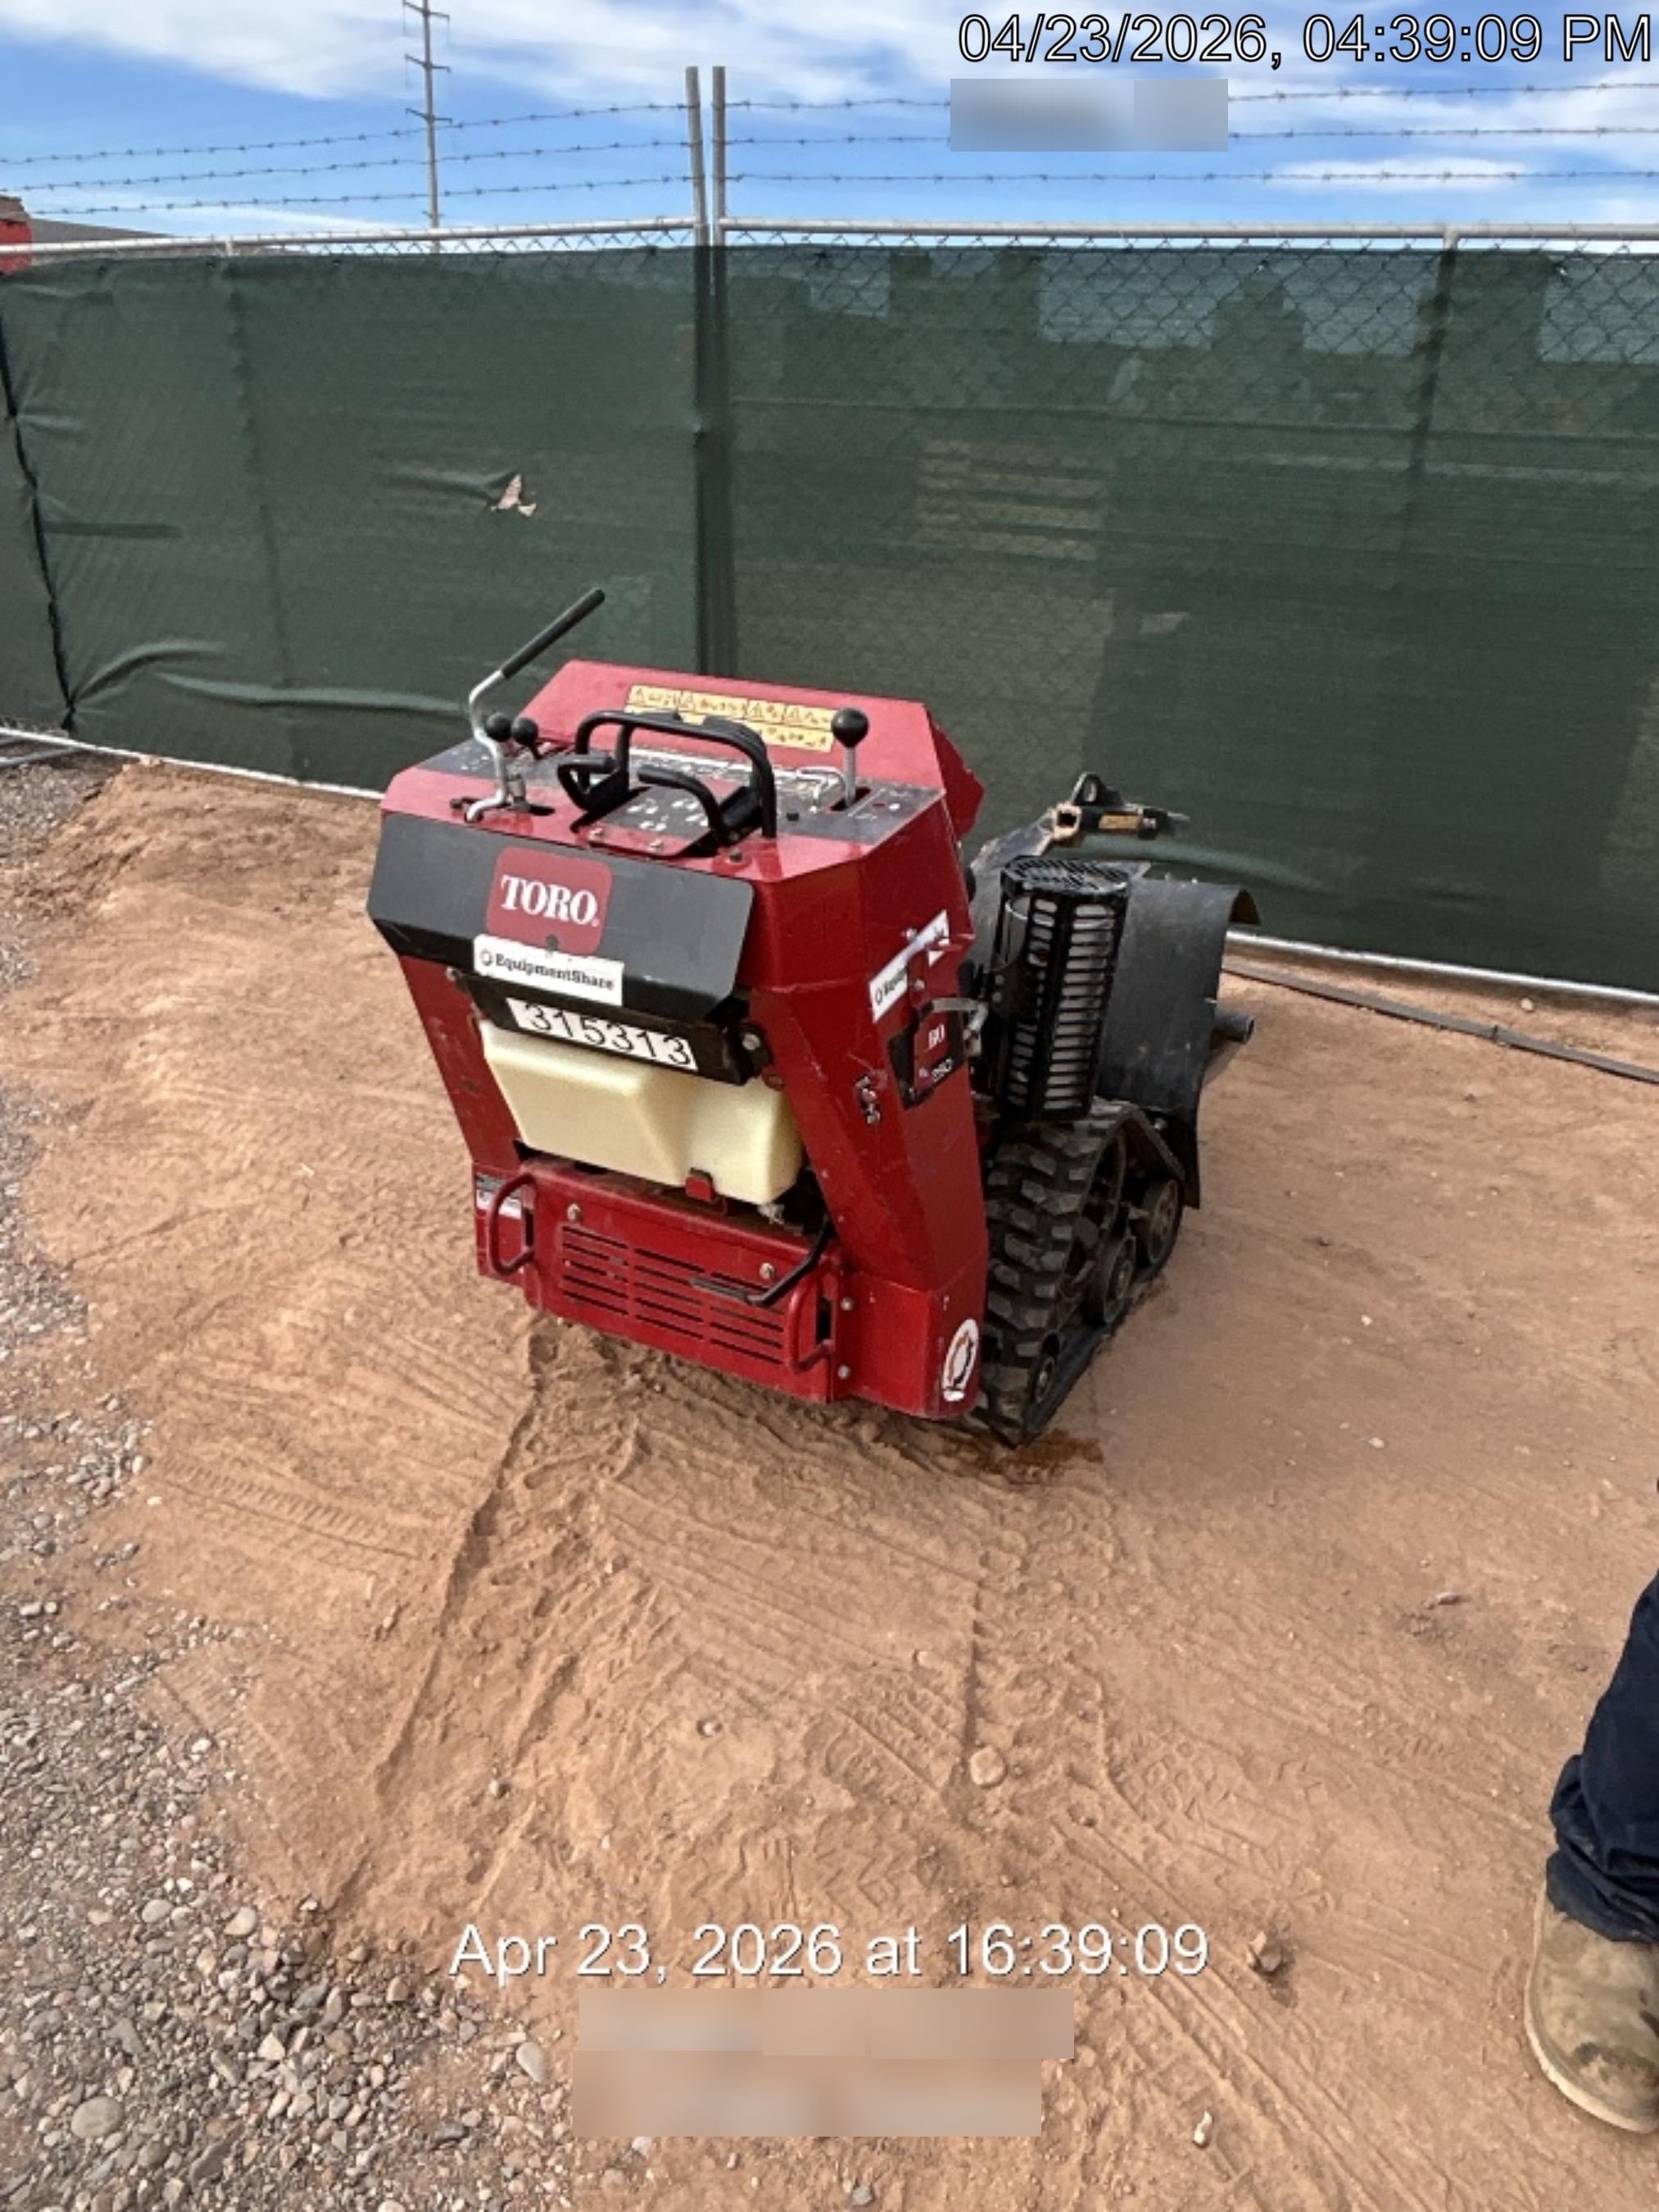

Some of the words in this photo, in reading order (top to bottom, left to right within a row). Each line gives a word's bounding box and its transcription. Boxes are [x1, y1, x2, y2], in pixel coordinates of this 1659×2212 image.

[501, 874, 597, 925] TORO
[496, 953, 614, 990] EquipmentShare
[524, 1003, 692, 1066] 315313
